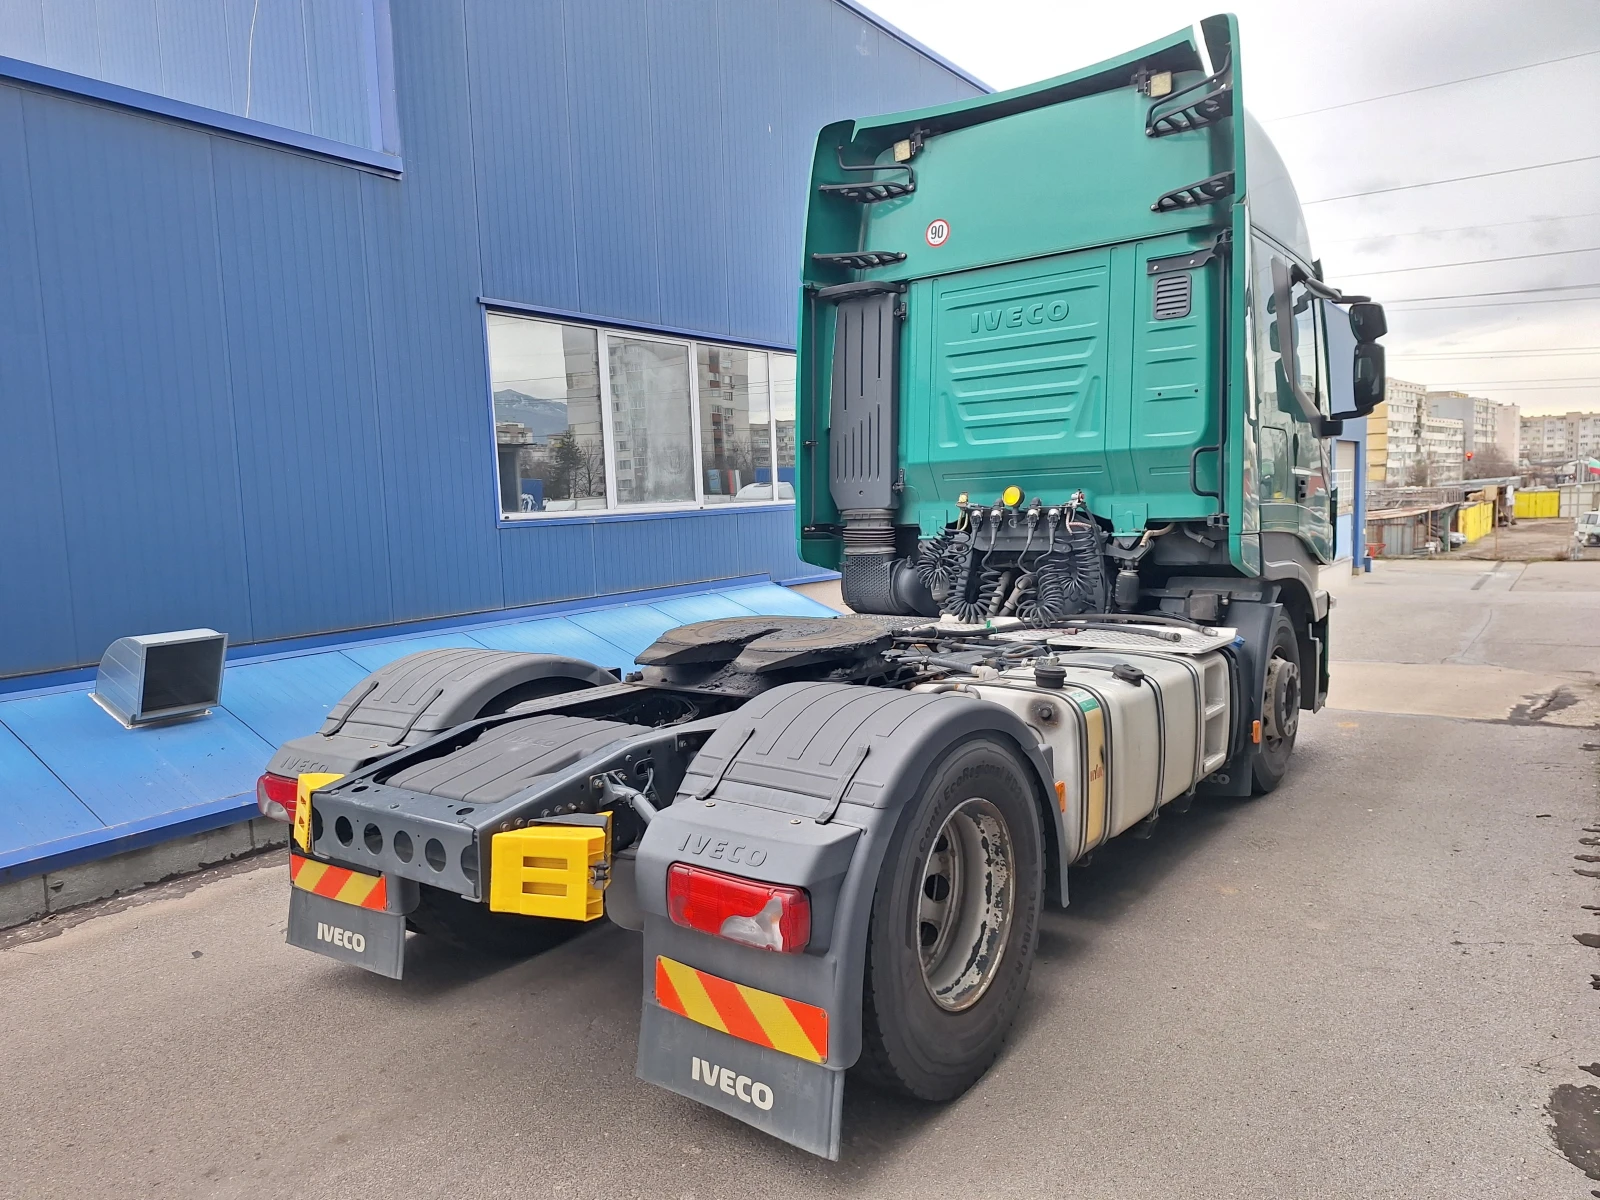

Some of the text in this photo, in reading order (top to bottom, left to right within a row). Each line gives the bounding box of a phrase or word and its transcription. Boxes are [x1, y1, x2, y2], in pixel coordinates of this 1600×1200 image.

[930, 224, 944, 240] 90
[970, 299, 1070, 334] IVECO
[280, 755, 329, 773] IVECO
[919, 799, 942, 853] Conti
[943, 760, 1005, 802] EcoRegional
[678, 832, 768, 868] IVECO
[316, 922, 366, 953] IVECO
[691, 1055, 775, 1111] IVECO
